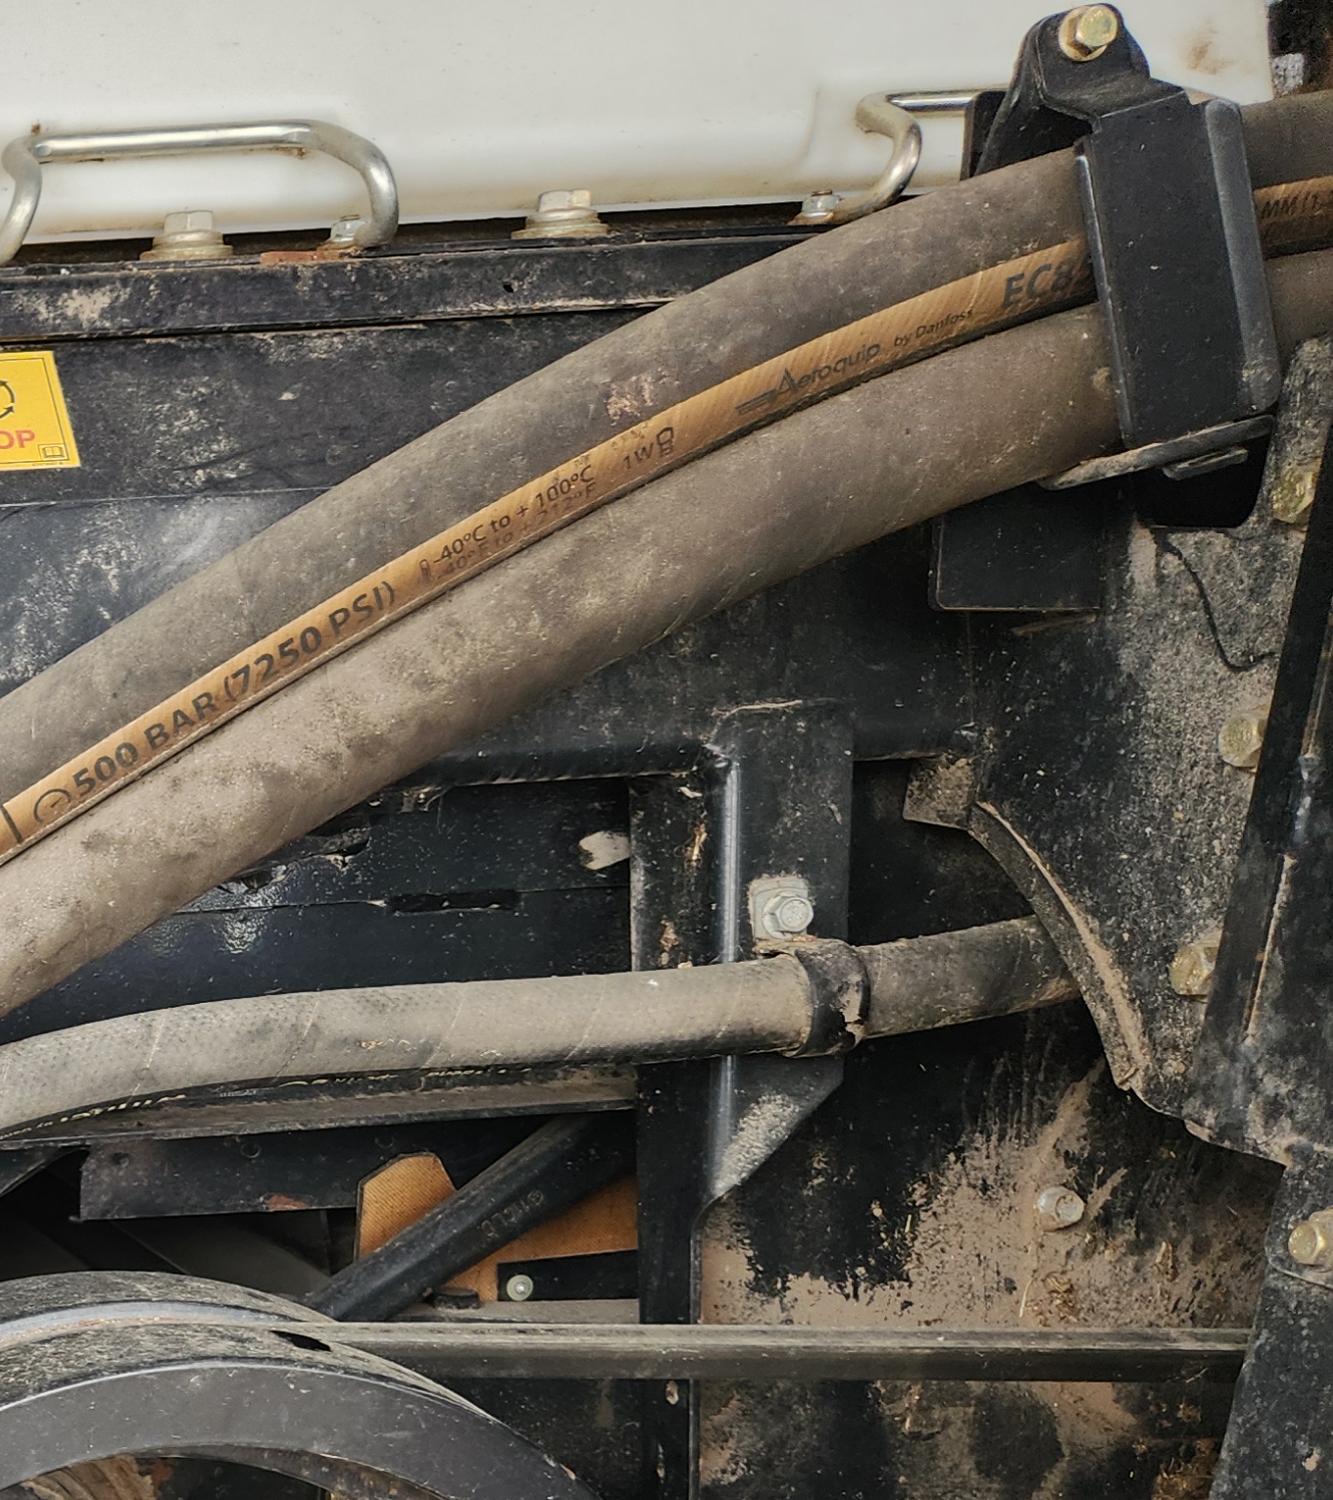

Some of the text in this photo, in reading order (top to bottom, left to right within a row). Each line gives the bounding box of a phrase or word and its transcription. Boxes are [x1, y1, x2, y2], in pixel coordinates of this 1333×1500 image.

[781, 307, 972, 395] Aeroquip by Danfoss
[489, 513, 511, 533] to
[516, 504, 529, 517] +
[535, 465, 595, 507] 100°C
[493, 531, 514, 547] to
[73, 580, 396, 797] 500 BAR (7250 PSI)
